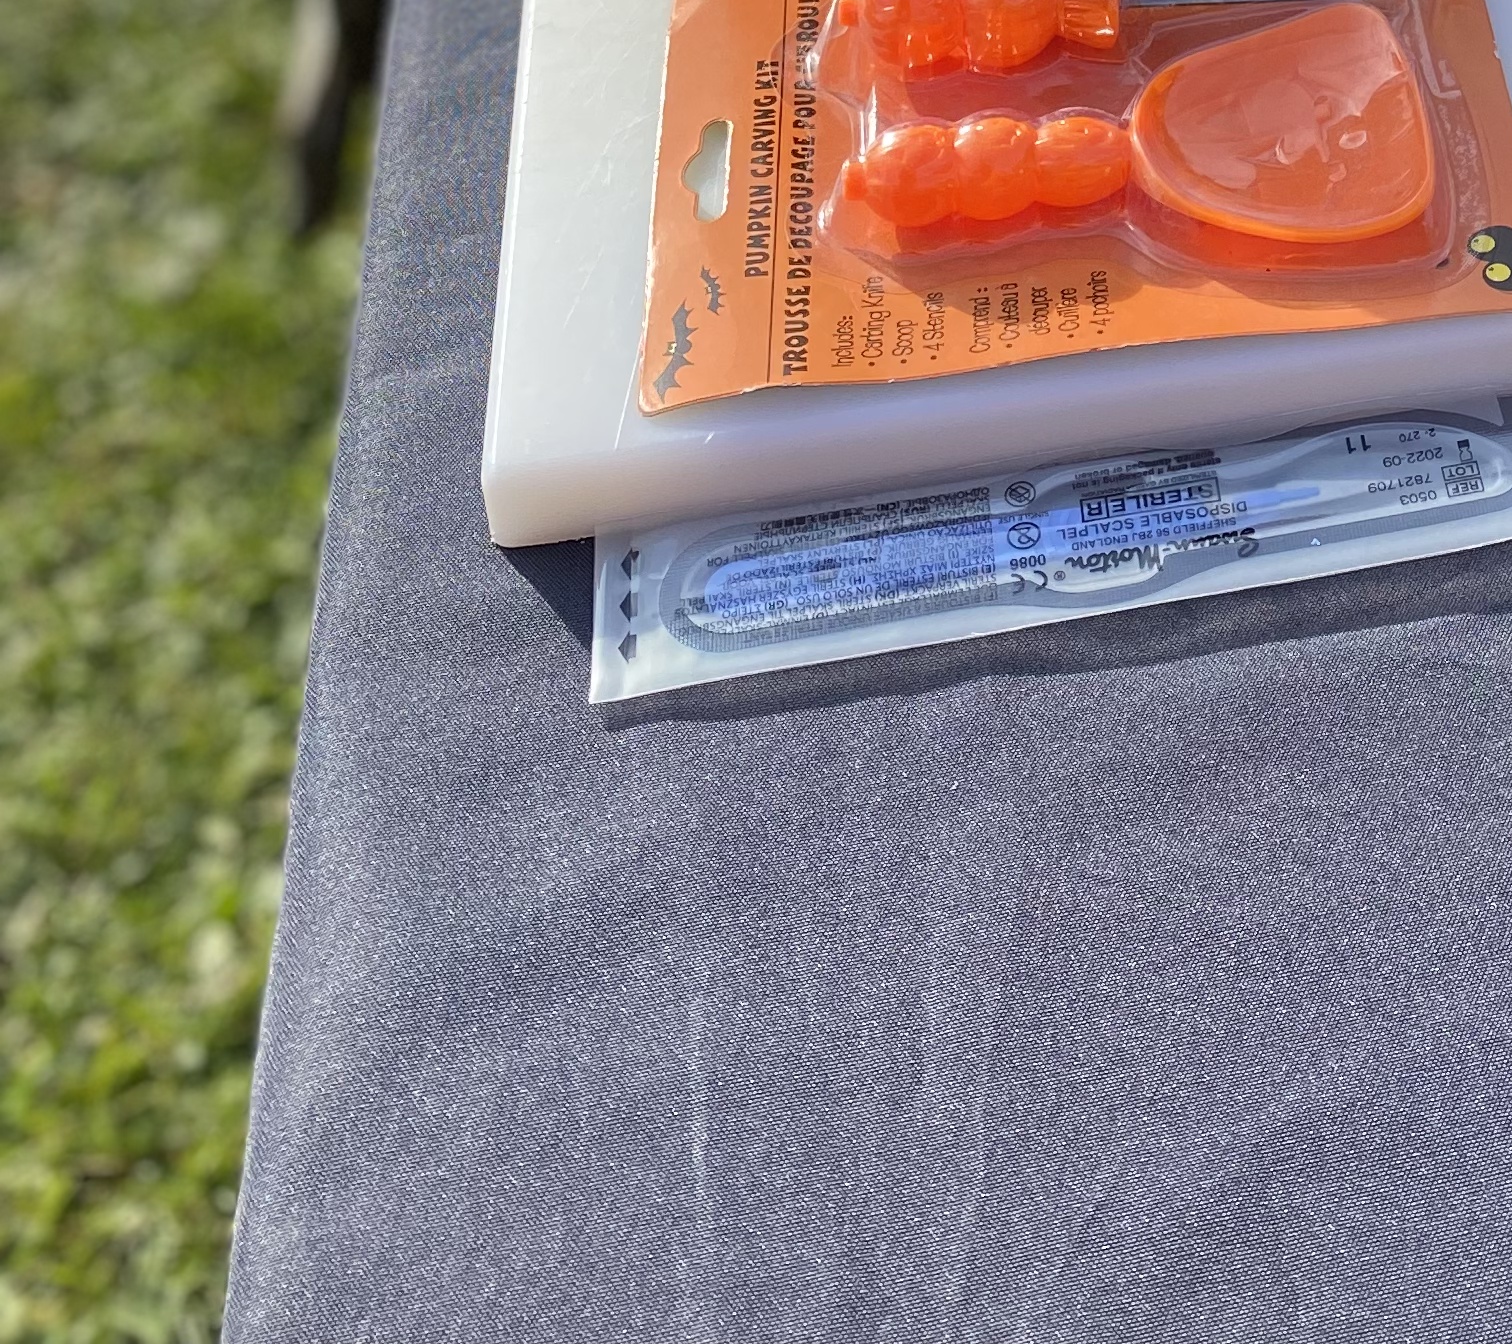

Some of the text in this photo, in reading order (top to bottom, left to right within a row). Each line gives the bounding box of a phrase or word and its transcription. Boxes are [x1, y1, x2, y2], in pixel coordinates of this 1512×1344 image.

[793, 81, 816, 129] POUR
[745, 60, 779, 277] PUMPKIN CARVING KIT
[788, 135, 815, 249] DECOUPAGE
[787, 255, 812, 279] DE
[862, 275, 883, 308] Knife
[1086, 269, 1116, 327] 4 pochoirs
[998, 291, 1019, 341] Couteau
[1029, 286, 1053, 336] découper
[922, 291, 945, 352] 4 Stencils
[783, 286, 811, 376] TROUSSE
[892, 319, 918, 357] Scoop
[831, 315, 853, 367] Includes:
[1344, 433, 1371, 454] 11
[1397, 430, 1420, 442] 270
[1381, 446, 1443, 468] 2022-09
[1073, 468, 1107, 482] broken
[1101, 467, 1155, 485] packaging
[1110, 465, 1122, 473] or
[1070, 480, 1088, 490] not
[1089, 478, 1100, 487] is
[1366, 464, 1474, 493] LOT 7821709
[1109, 482, 1214, 512] STERILE
[1398, 479, 1478, 505] REF 0503
[875, 500, 900, 511] (CN)
[1084, 499, 1103, 517] R
[1054, 498, 1247, 541] DISPOSABLE SCALPEL
[1070, 515, 1236, 551] SHEFFIELD S6 2BJ ENGLAND
[805, 542, 859, 559] STERYLNY
[861, 536, 885, 548] (PL)
[866, 545, 882, 555] (P)
[757, 552, 803, 567] SKALPEL
[904, 552, 944, 566] BISTURI
[1008, 553, 1046, 570] 0086
[841, 559, 901, 577] MONOUSO
[936, 566, 978, 581] BISTURI
[980, 562, 996, 574] (E)
[773, 577, 791, 589] (N)
[808, 578, 846, 593] STERIL
[848, 574, 865, 585] (H)
[875, 580, 890, 591] DE
[892, 573, 934, 588] ESTERIL
[961, 573, 996, 587] STERIL
[735, 582, 771, 596] STERIL
[754, 584, 808, 602] EGYSZER
[822, 587, 852, 601] SOLO
[853, 583, 872, 595] UN
[874, 589, 899, 602] (DK)
[763, 598, 788, 611] (GR)
[784, 600, 833, 617] SKALPEL
[836, 593, 871, 608] STERIL
[767, 608, 783, 620] TIL
